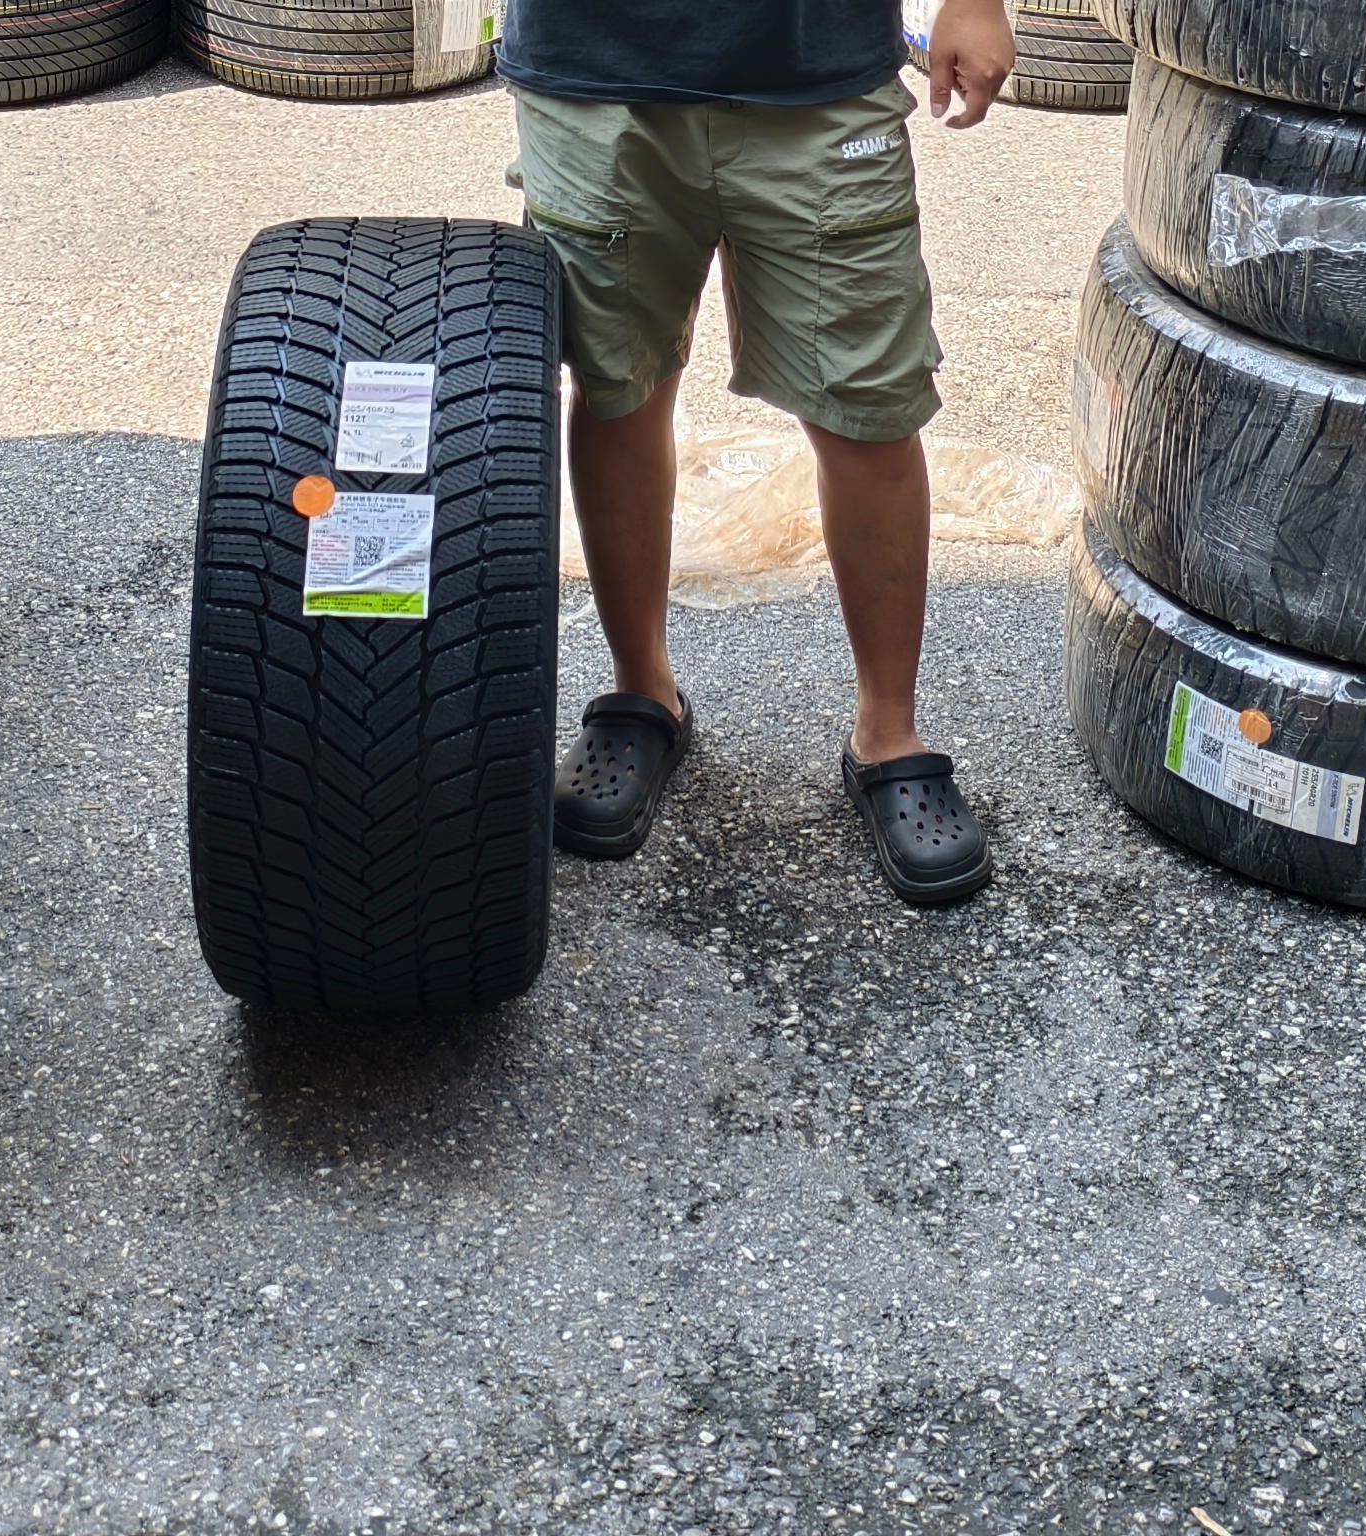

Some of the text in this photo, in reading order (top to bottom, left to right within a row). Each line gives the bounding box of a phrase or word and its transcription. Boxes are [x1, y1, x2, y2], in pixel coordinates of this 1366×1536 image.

[344, 415, 366, 423] 112T
[1300, 766, 1310, 785] 101H
[1343, 797, 1358, 838] MICHELIN
